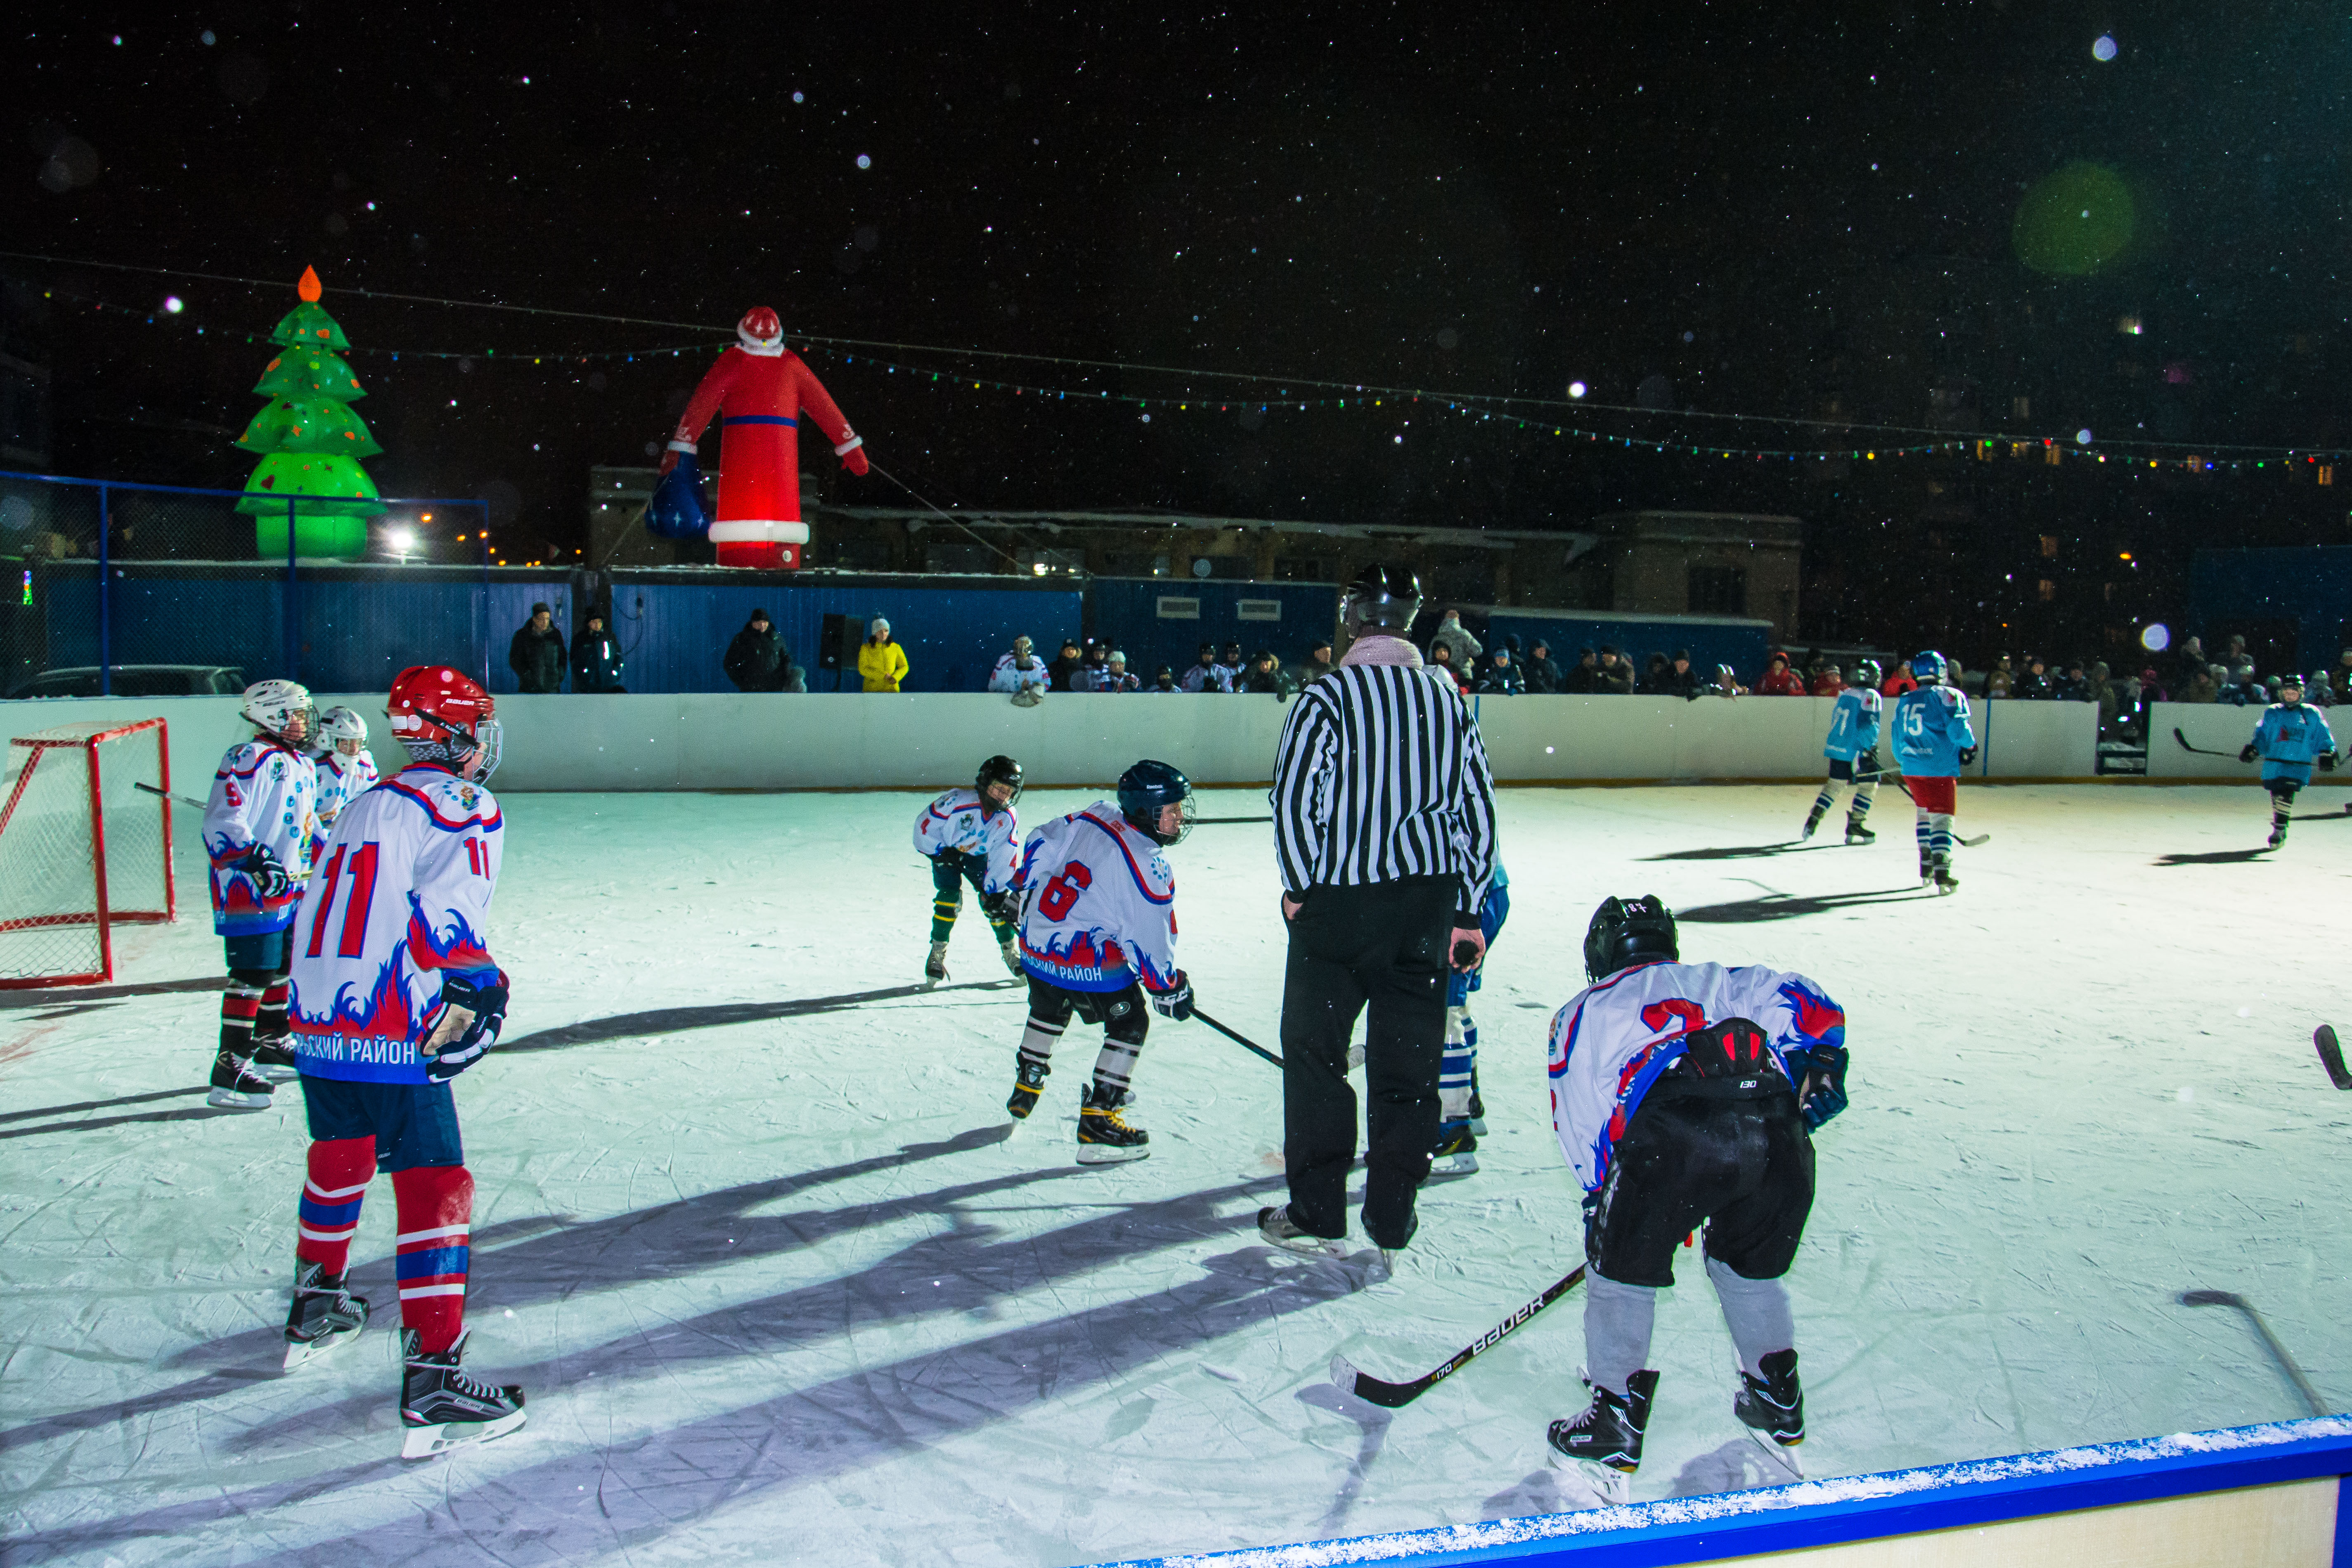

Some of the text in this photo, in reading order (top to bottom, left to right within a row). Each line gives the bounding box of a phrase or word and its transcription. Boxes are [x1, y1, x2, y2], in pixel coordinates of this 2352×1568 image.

[1902, 703, 1926, 736] 15
[463, 836, 490, 880] 11
[305, 841, 380, 959] 11
[1038, 859, 1092, 923] 6
[1628, 903, 1647, 913] 87
[1059, 964, 1102, 981] РАЙОН
[350, 1034, 416, 1064] РАЙОН
[1740, 1080, 1757, 1089] 130
[1472, 1294, 1544, 1356] BAUER
[1436, 1363, 1452, 1380] 170
